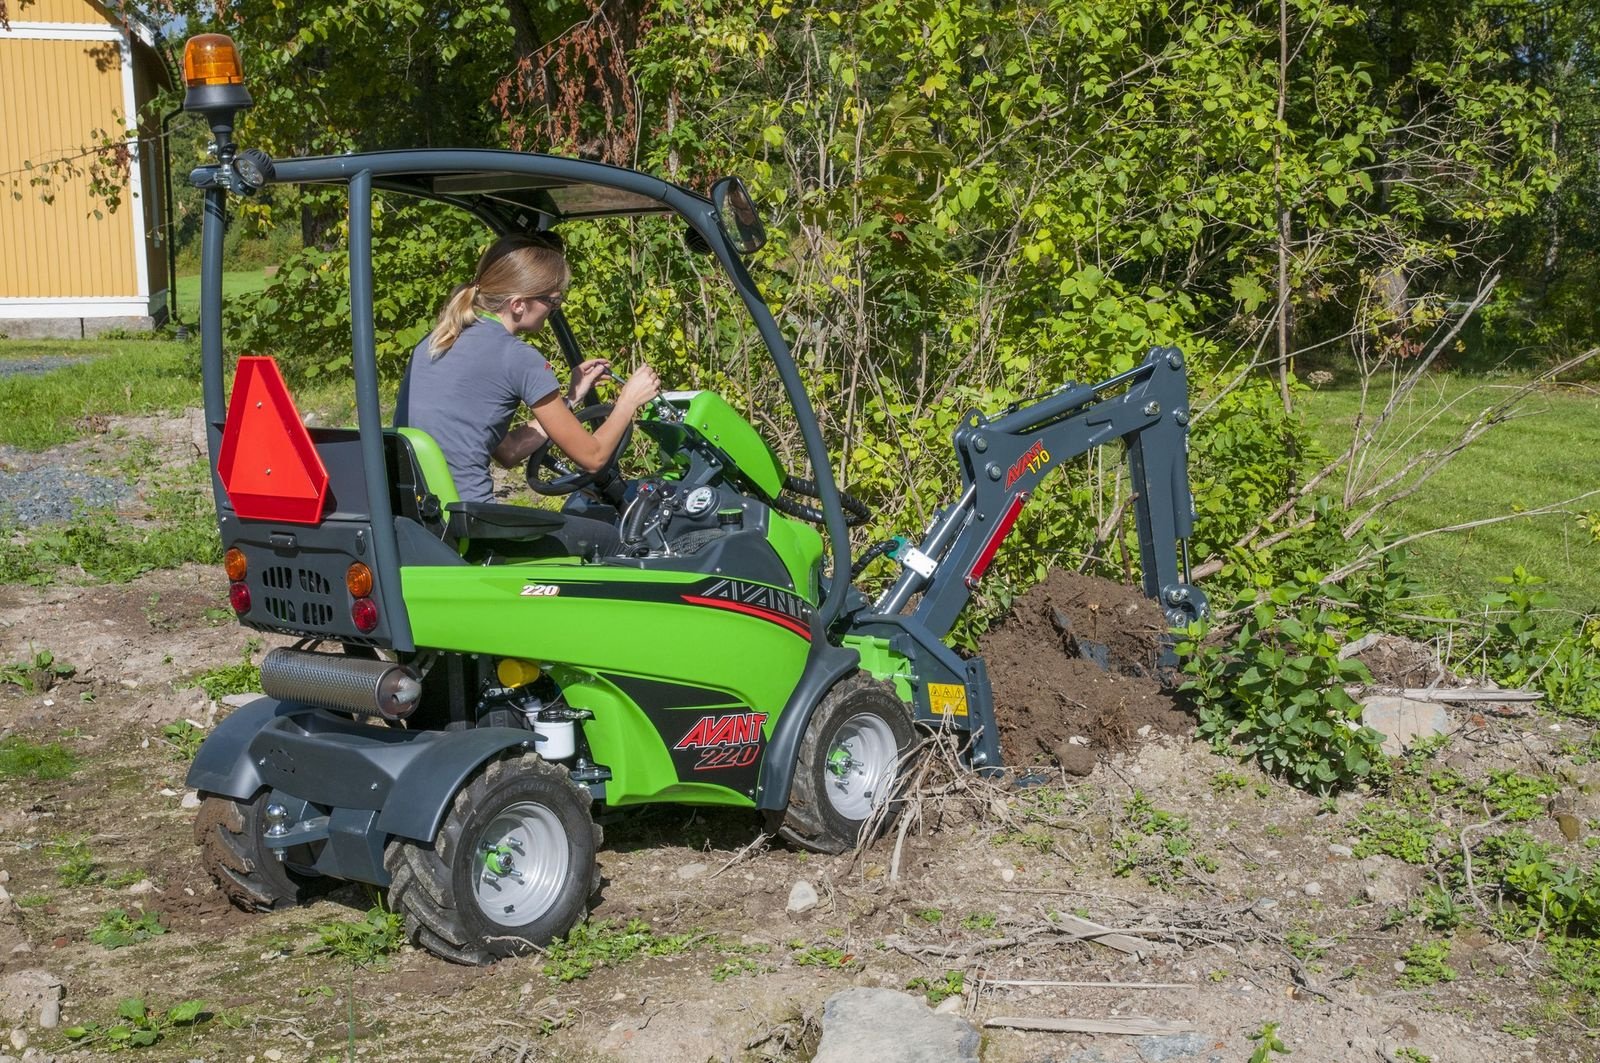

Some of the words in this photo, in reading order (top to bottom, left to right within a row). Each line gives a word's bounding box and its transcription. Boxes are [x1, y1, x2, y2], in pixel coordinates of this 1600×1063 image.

[1005, 439, 1044, 491] AVANT
[1027, 450, 1051, 475] 170
[520, 584, 560, 596] 220
[673, 713, 768, 750] AVANT
[694, 744, 760, 770] 220
